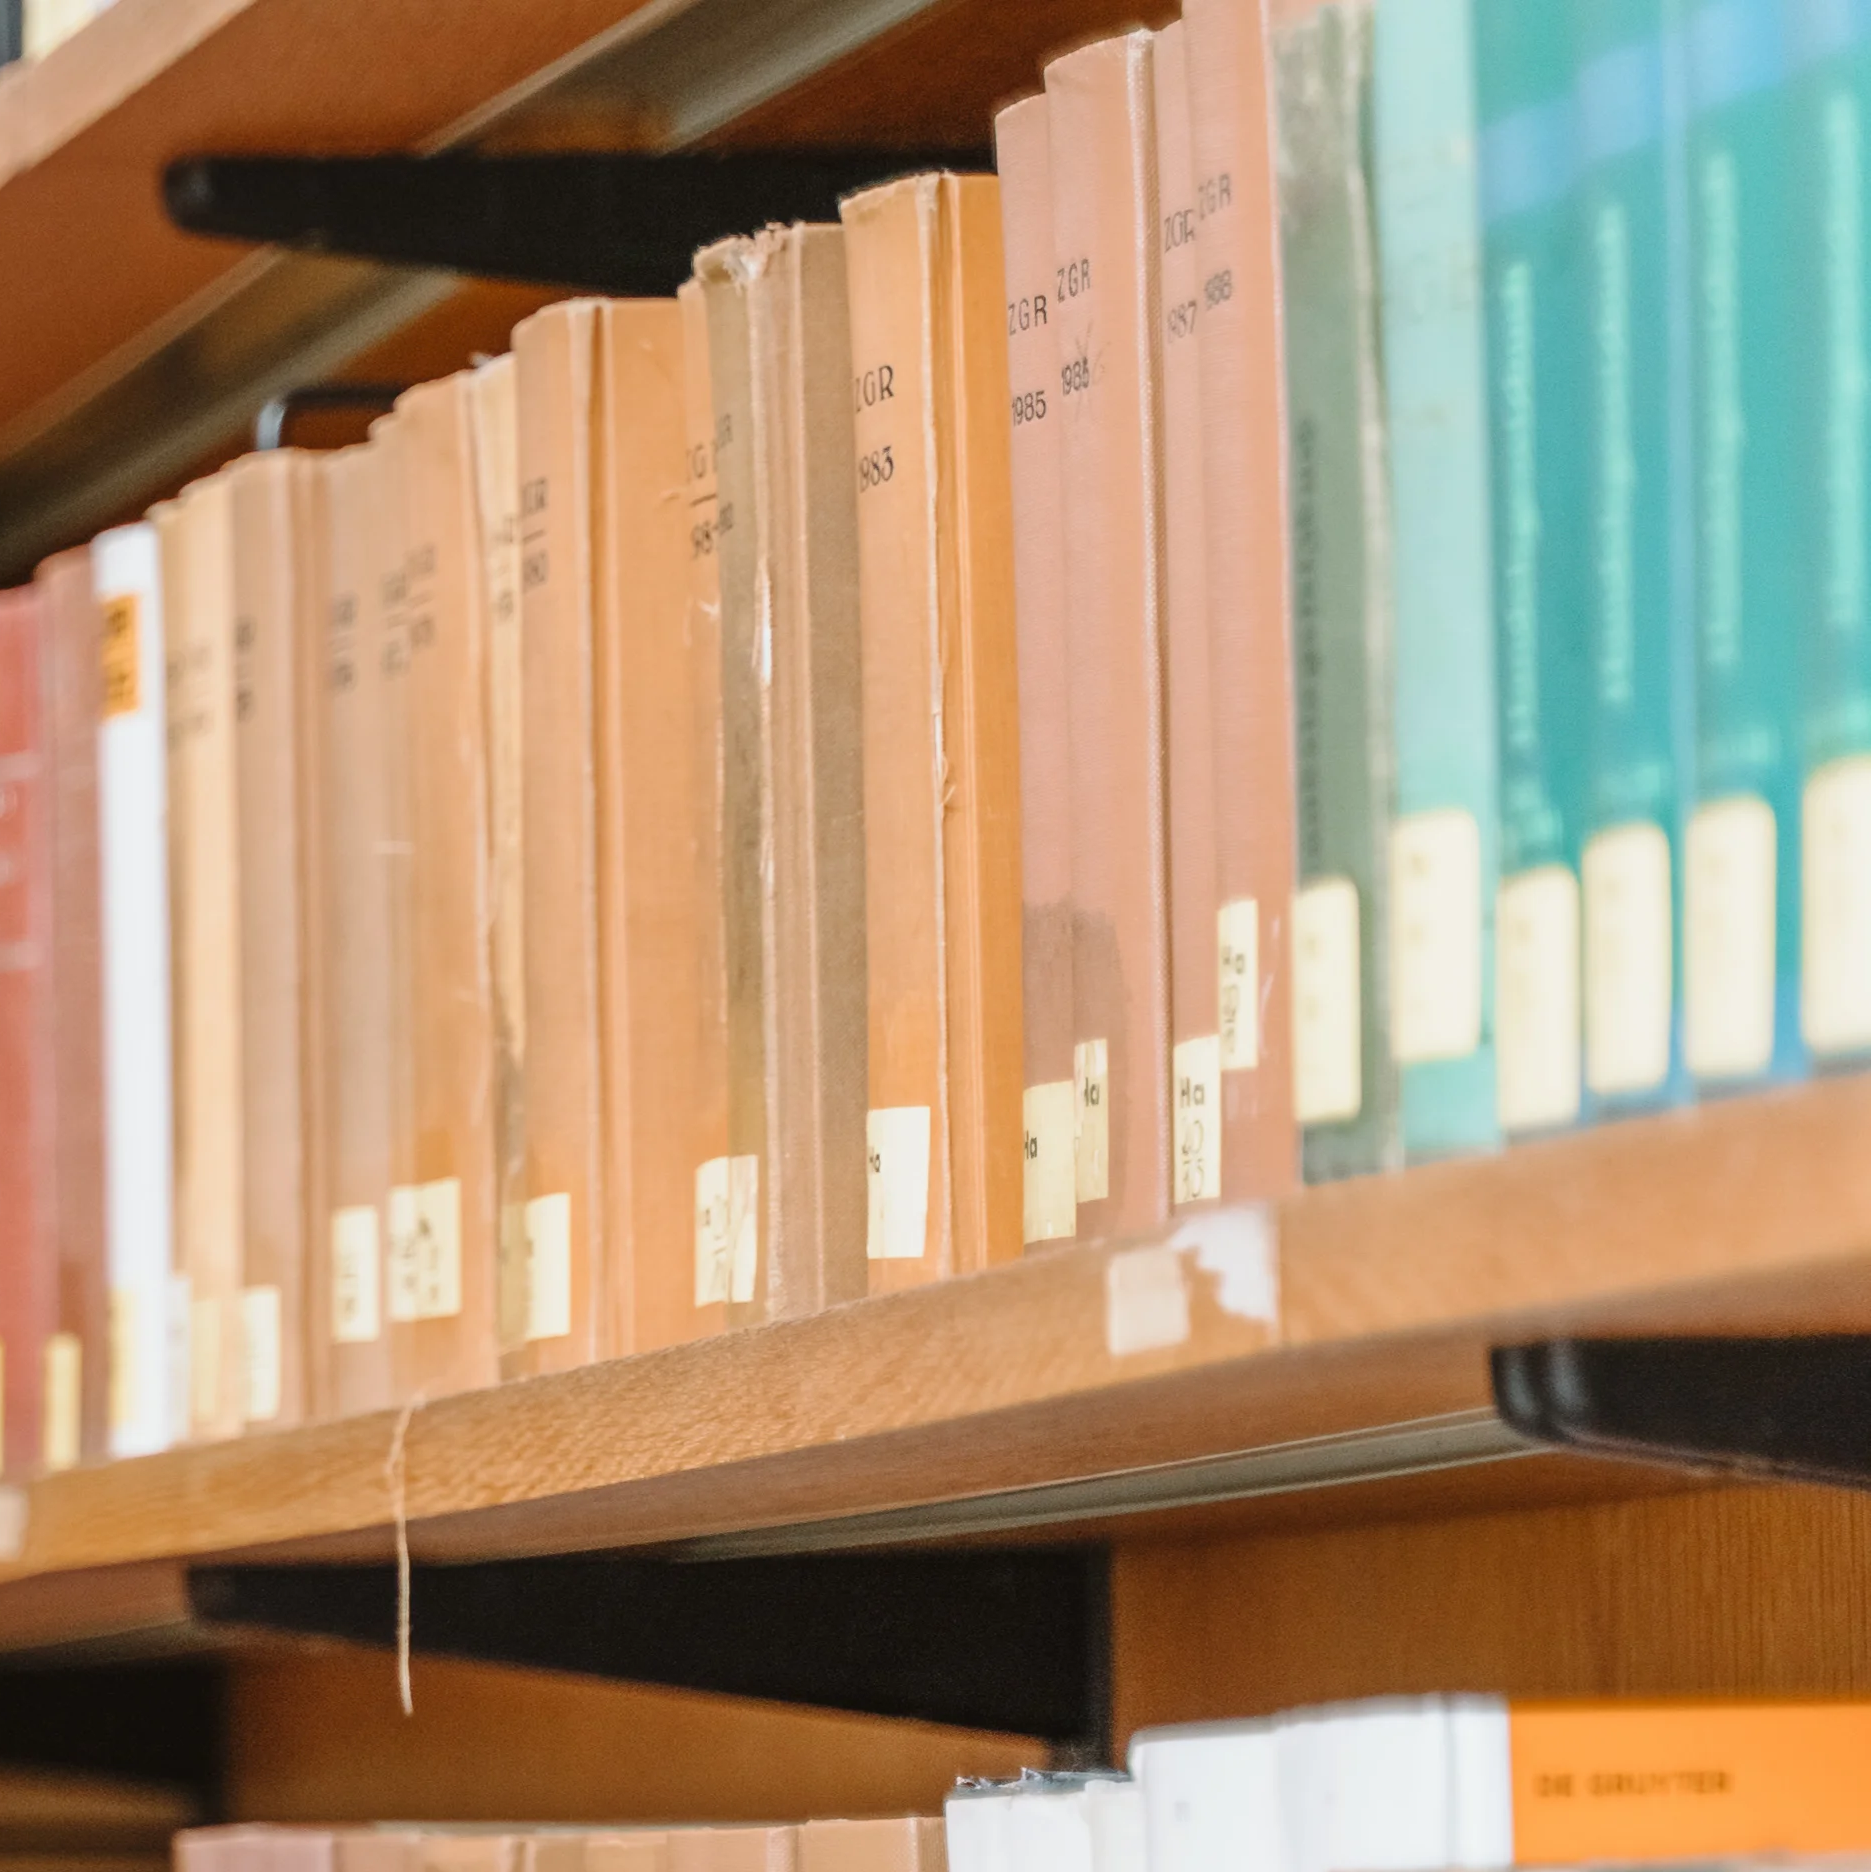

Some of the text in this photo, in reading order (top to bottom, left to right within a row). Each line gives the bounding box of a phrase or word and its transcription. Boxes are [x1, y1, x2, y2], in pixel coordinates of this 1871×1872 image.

[1058, 259, 1091, 303] ZGR
[1008, 295, 1048, 336] ZGR
[1012, 390, 1047, 427] 1985
[1180, 1077, 1205, 1109] Ha
